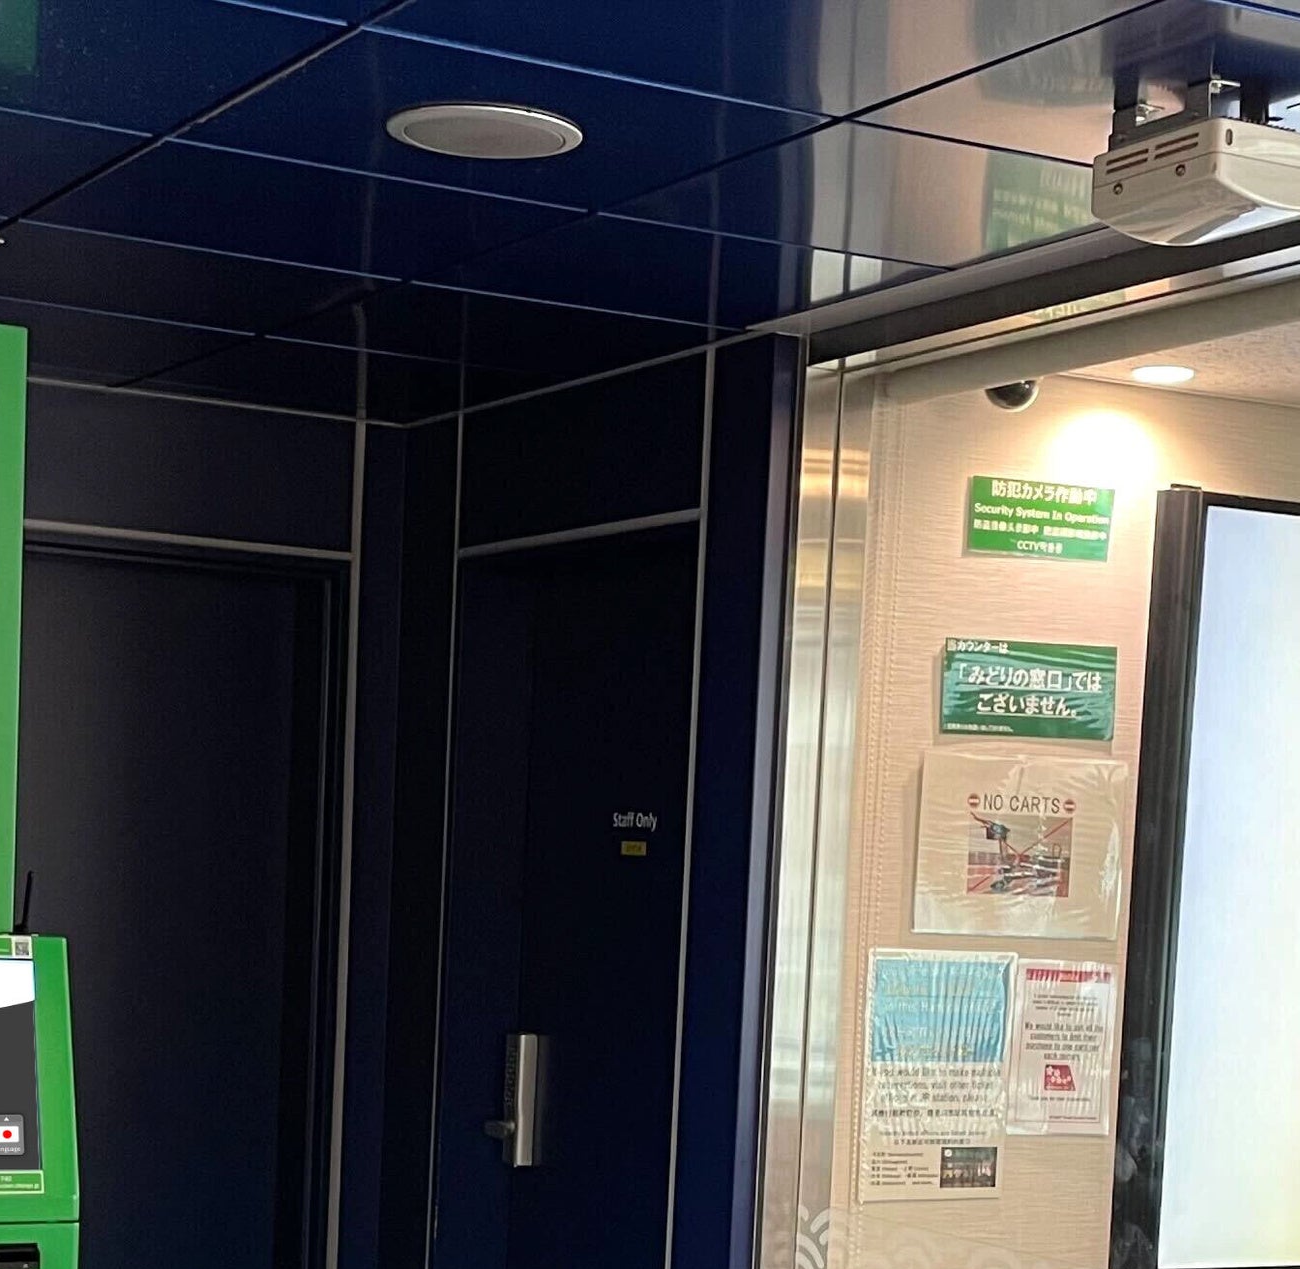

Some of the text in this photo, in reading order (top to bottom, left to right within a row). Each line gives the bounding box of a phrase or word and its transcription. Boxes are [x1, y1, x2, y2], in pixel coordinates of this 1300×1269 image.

[991, 479, 1098, 506] 防犯カメラ作動中
[974, 503, 1015, 518] Security
[1015, 507, 1050, 520] System
[1065, 511, 1111, 526] Operation
[959, 663, 1103, 692] 「みどりの窓口」では
[976, 693, 1078, 718] ございません。
[983, 794, 1060, 815] NO CARTS
[613, 812, 657, 832] Staff Only
